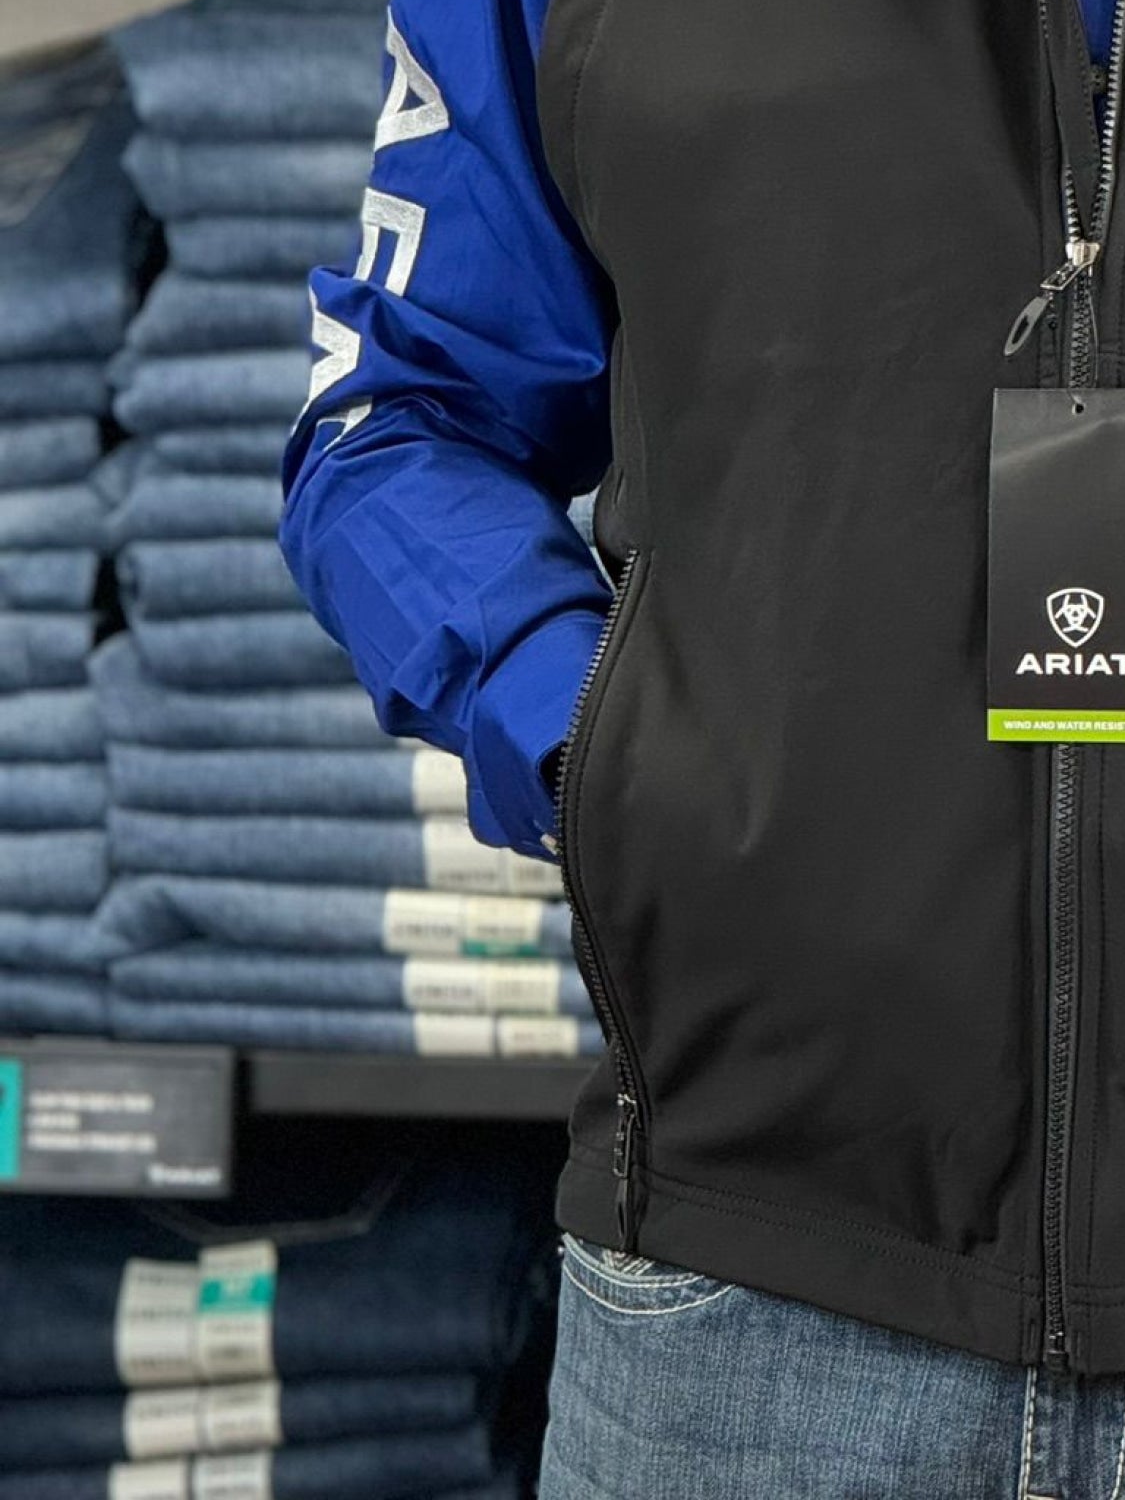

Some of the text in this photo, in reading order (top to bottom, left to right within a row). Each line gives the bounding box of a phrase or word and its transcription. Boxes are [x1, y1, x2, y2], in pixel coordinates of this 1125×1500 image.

[1003, 720, 1032, 730] WIND
[1033, 720, 1056, 731] AND
[1057, 720, 1092, 731] WATER
